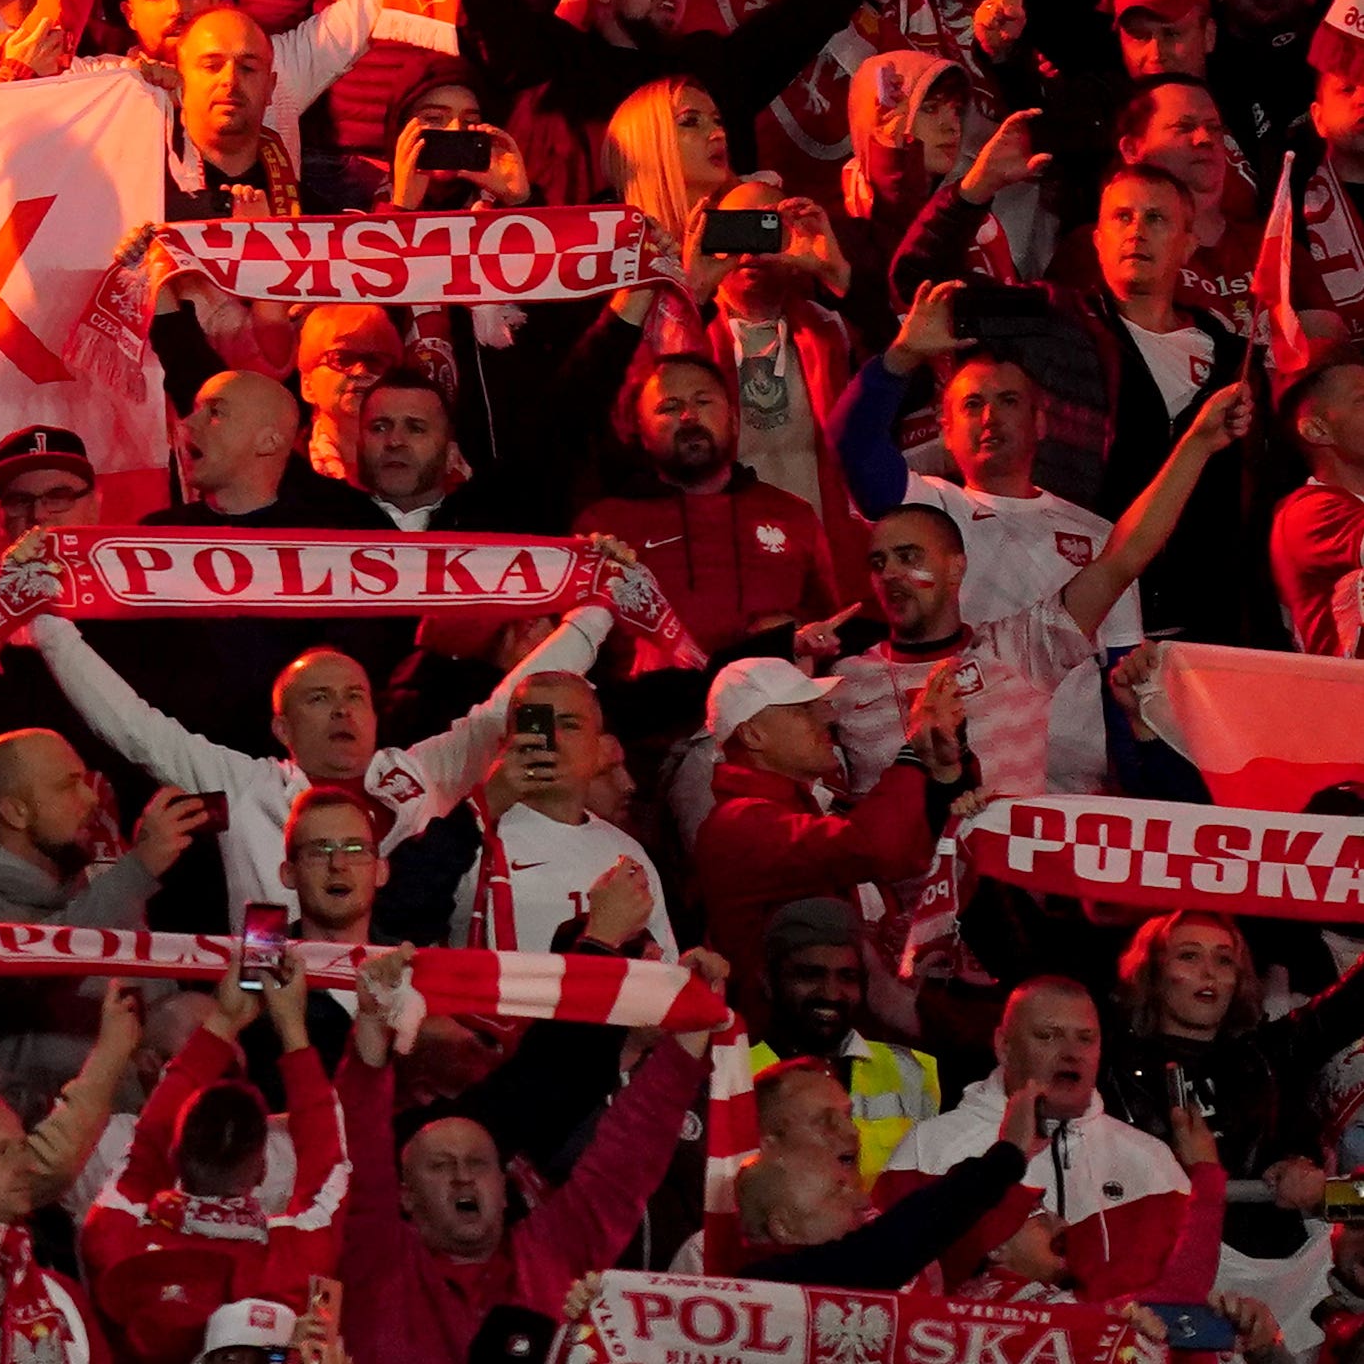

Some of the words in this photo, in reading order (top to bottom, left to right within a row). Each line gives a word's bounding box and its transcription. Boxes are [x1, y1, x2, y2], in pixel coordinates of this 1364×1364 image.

[175, 210, 626, 297] POLSKA
[115, 546, 551, 597] POLSKA
[623, 1289, 793, 1356] POL
[906, 1319, 1072, 1364] SKA
[948, 1301, 1051, 1323] WIERNI
